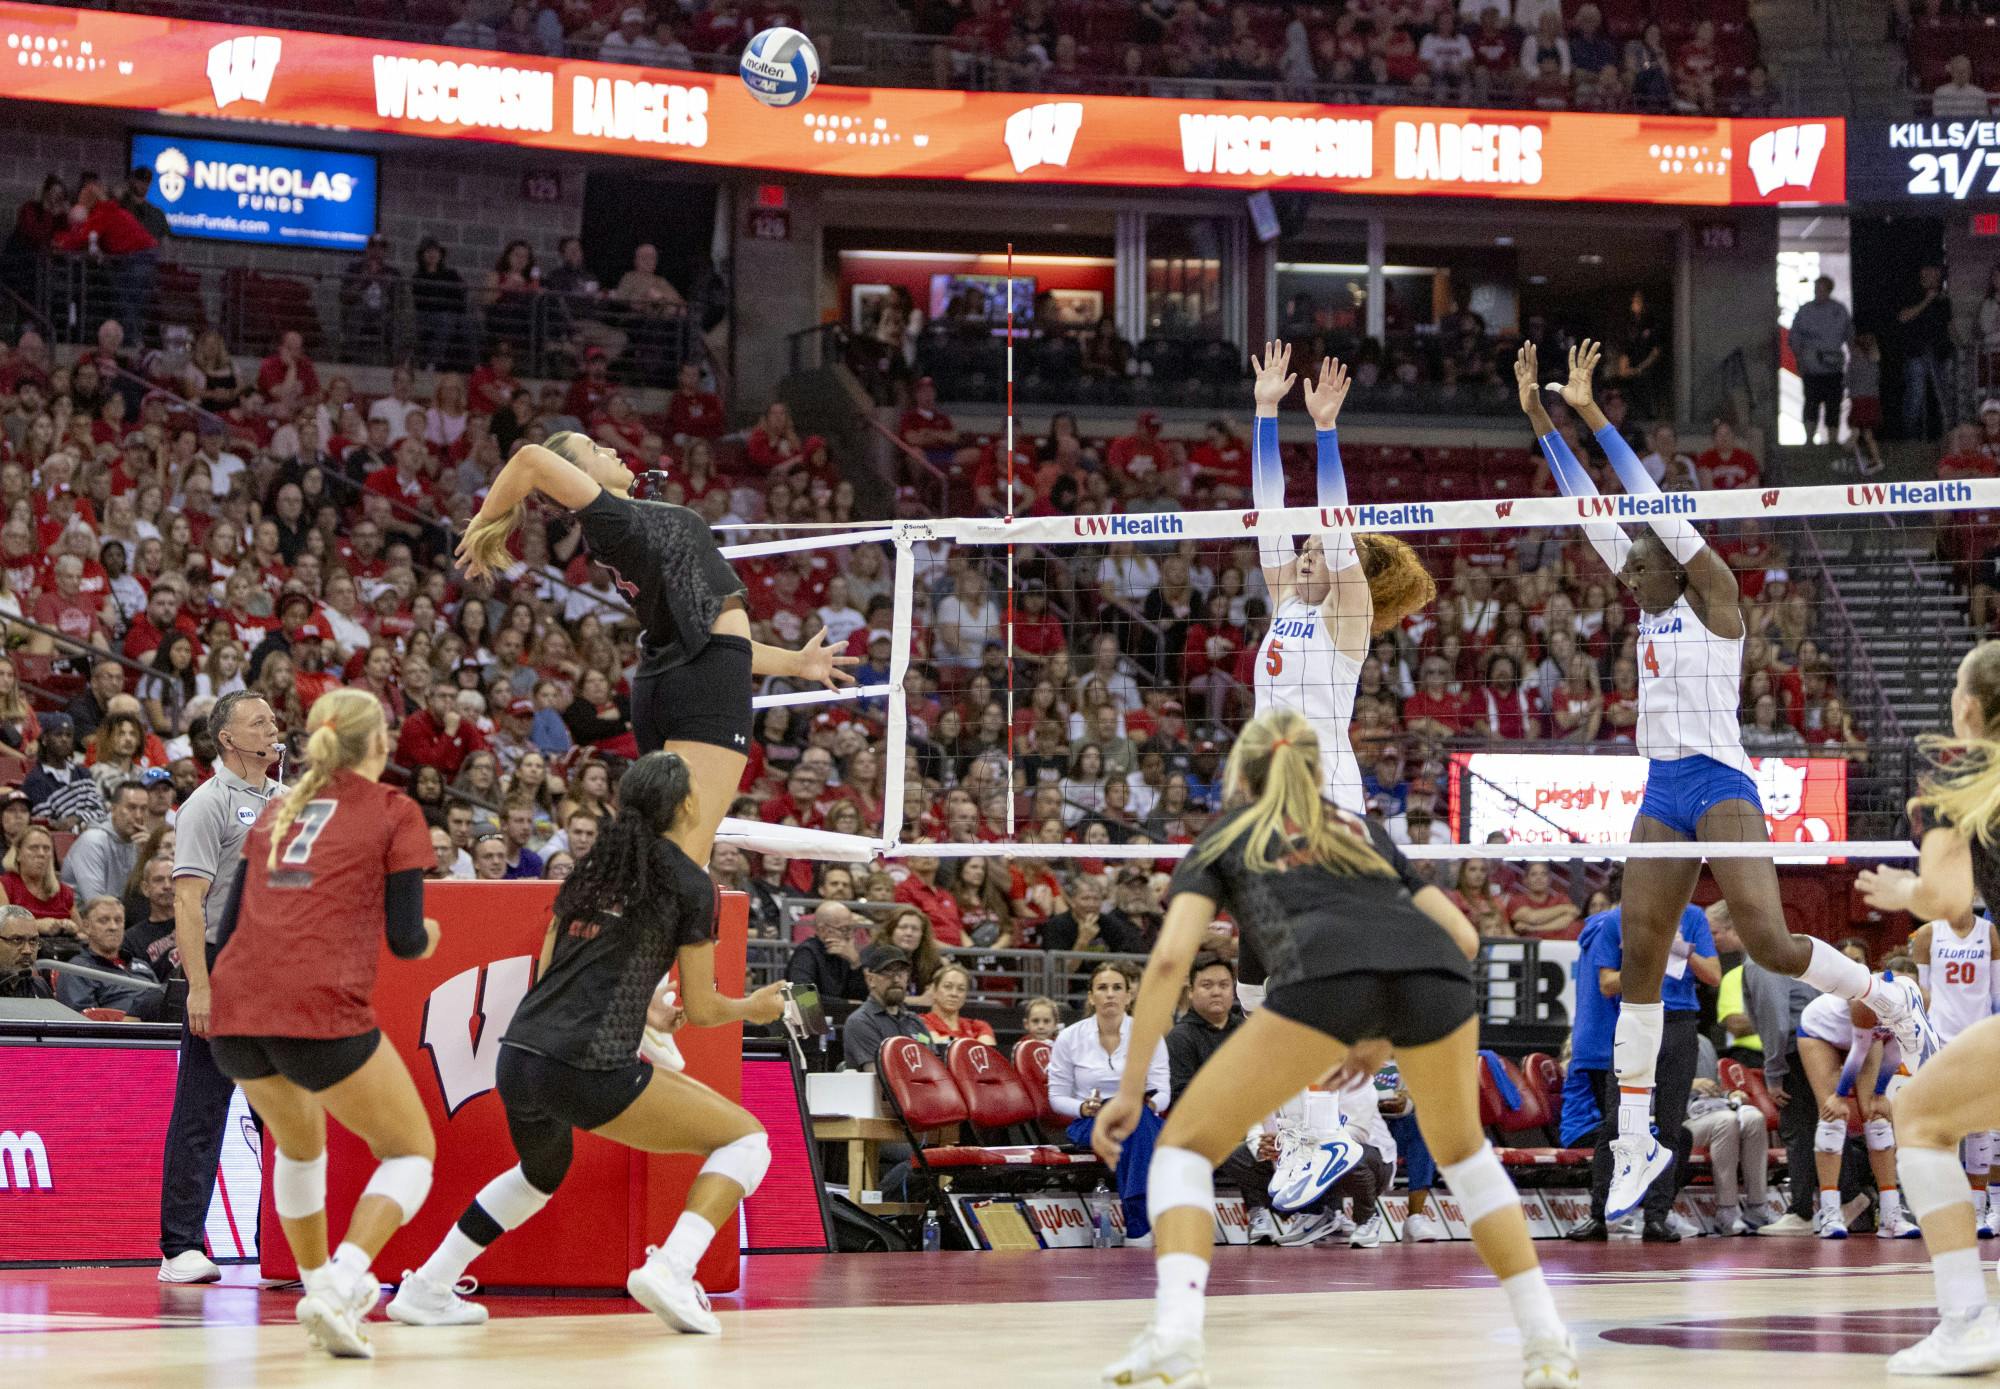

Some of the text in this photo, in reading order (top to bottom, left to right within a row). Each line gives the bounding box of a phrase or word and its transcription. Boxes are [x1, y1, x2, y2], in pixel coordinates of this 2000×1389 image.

[745, 58, 784, 78] molten
[373, 54, 554, 132] WISCONSIN
[573, 75, 708, 148] BADGERS
[1179, 113, 1373, 178] WISCONSIN
[1394, 121, 1543, 184] BADGERS
[1889, 119, 2000, 150] KILLS/E
[193, 159, 352, 203] NICHOLAS
[237, 192, 304, 214] FUNDS
[1266, 639, 1284, 677] 5
[1644, 639, 1660, 678] 4
[280, 799, 339, 864] 7
[1937, 947, 1985, 959] FLORIDA
[1945, 961, 1976, 985] 20
